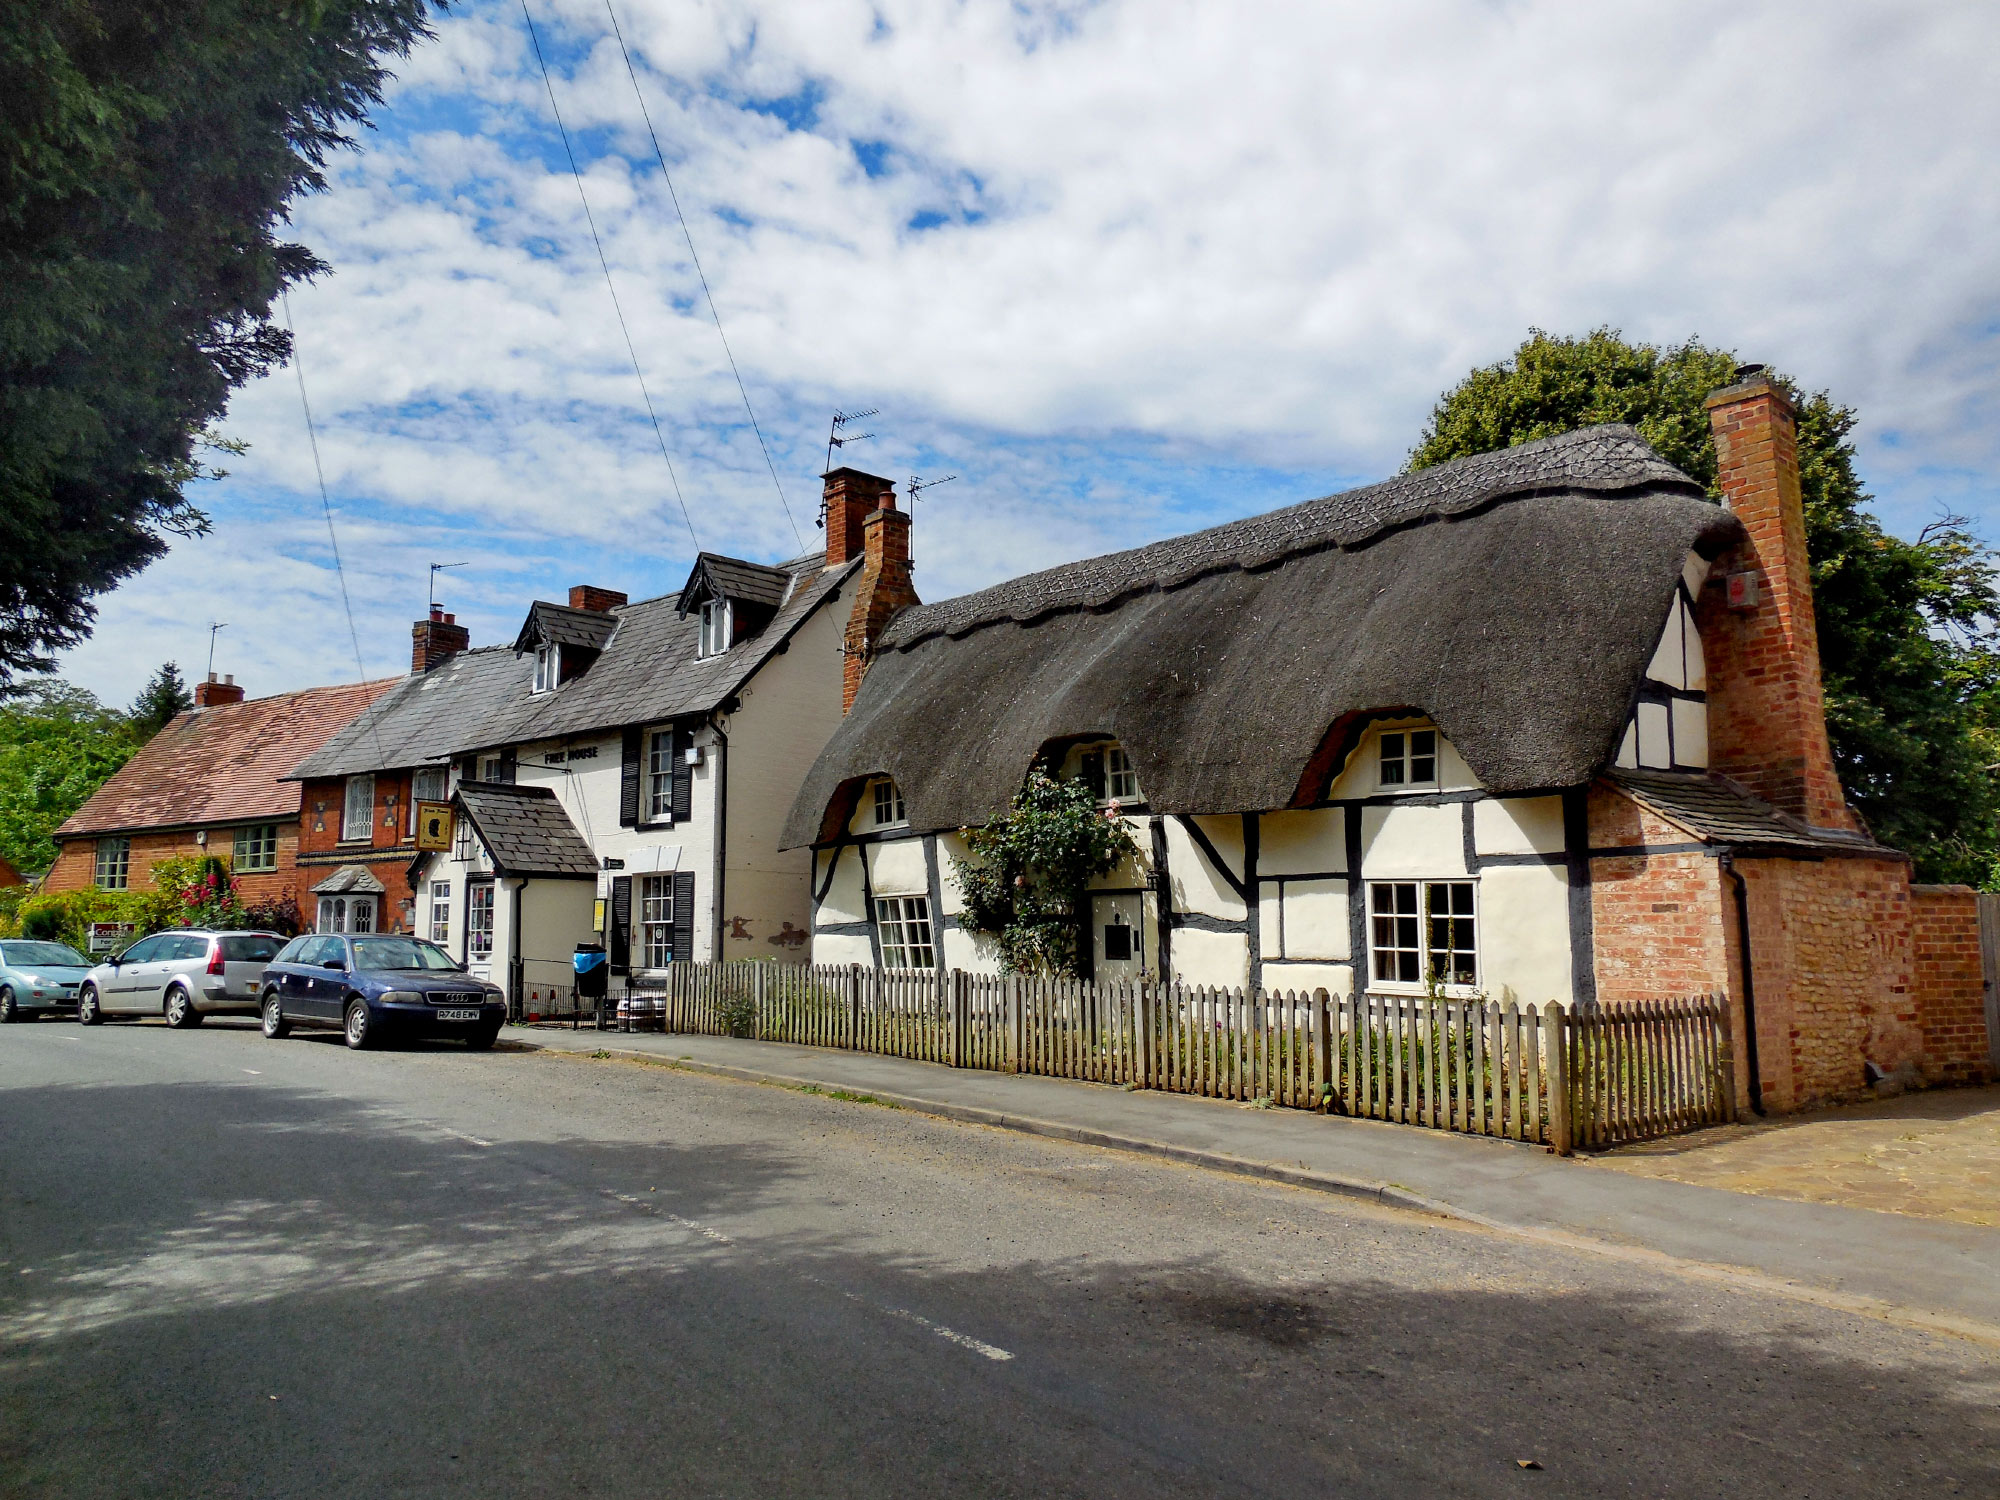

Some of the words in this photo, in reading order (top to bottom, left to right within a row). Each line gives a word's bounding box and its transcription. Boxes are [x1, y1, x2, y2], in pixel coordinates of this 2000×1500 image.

[544, 751, 565, 764] FREE
[568, 746, 599, 761] HOUSE
[438, 1011, 461, 1019] R748
